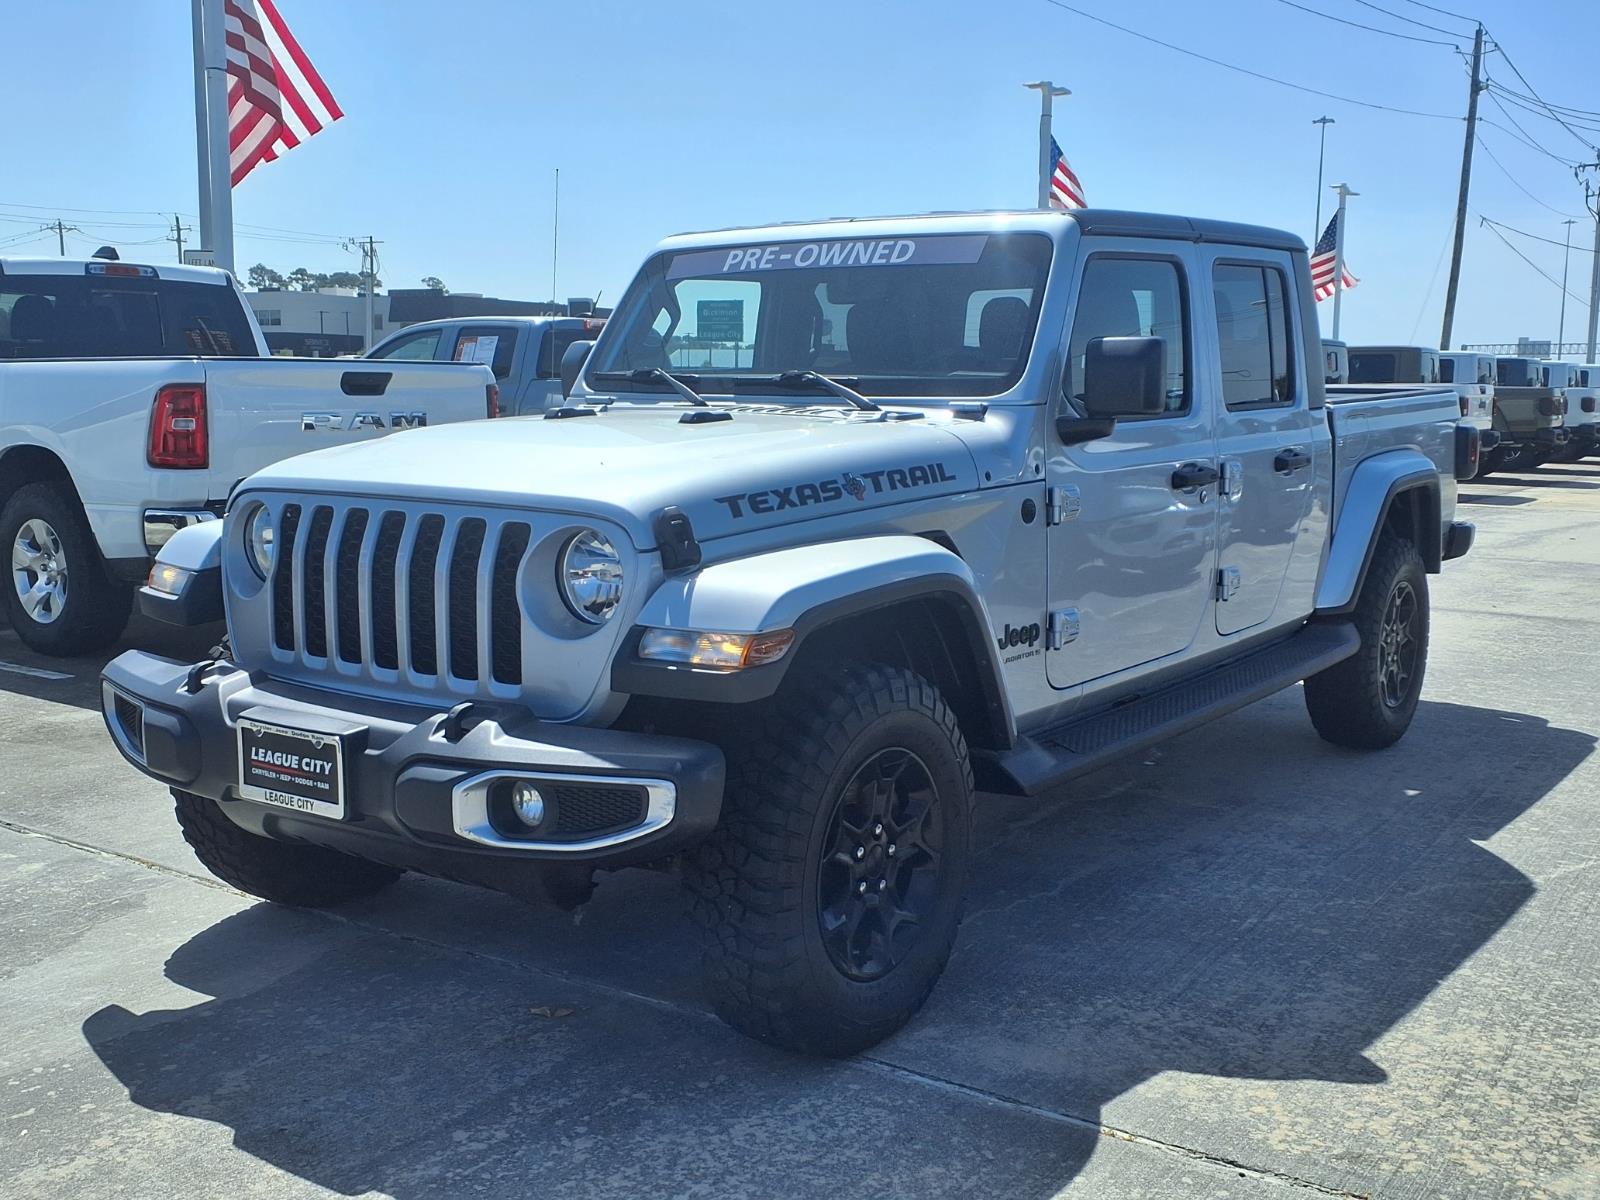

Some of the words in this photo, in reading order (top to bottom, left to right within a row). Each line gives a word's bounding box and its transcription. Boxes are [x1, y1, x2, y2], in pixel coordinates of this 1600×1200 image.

[722, 240, 916, 272] PRE-OWNED
[302, 411, 427, 431] RAM
[713, 479, 843, 519] TEXAS
[861, 462, 957, 493] TRAIL
[998, 622, 1040, 650] Jeep
[251, 747, 299, 769] LEAGUE
[301, 757, 332, 775] CITY
[251, 767, 276, 779] CHRYSLER
[279, 773, 292, 782] JEEP
[295, 776, 314, 787] DODGE
[317, 781, 330, 790] RAM
[264, 790, 295, 807] LEAGUE
[296, 799, 315, 811] CITY
